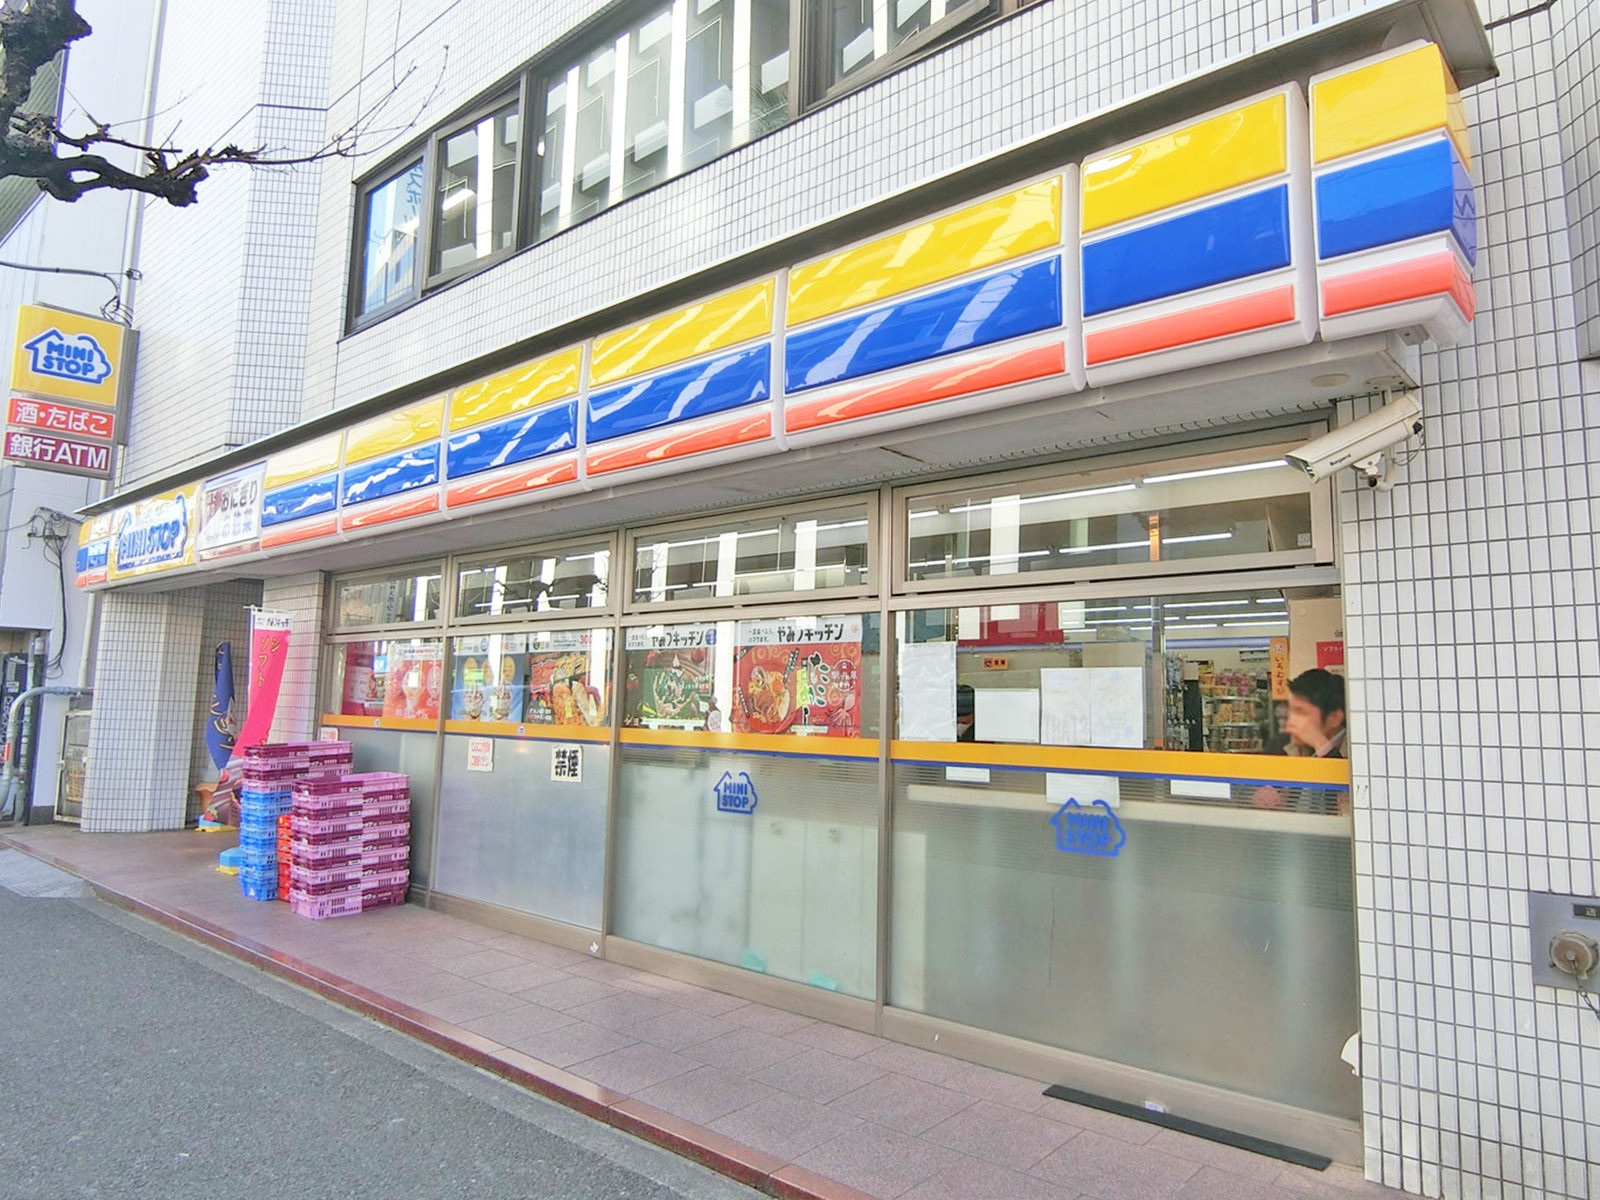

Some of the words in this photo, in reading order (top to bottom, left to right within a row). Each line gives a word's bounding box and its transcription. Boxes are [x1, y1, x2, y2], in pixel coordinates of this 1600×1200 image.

[47, 341, 94, 362] MINI
[43, 355, 95, 375] STOP
[15, 402, 108, 435] 酒・たばこ
[9, 433, 107, 470] 銀行ATM
[147, 519, 181, 554] STOP
[258, 636, 270, 688] ソフト
[555, 749, 579, 777] 禁煙
[724, 782, 747, 795] MINI
[722, 794, 749, 808] STOP
[1065, 830, 1111, 849] STOP
